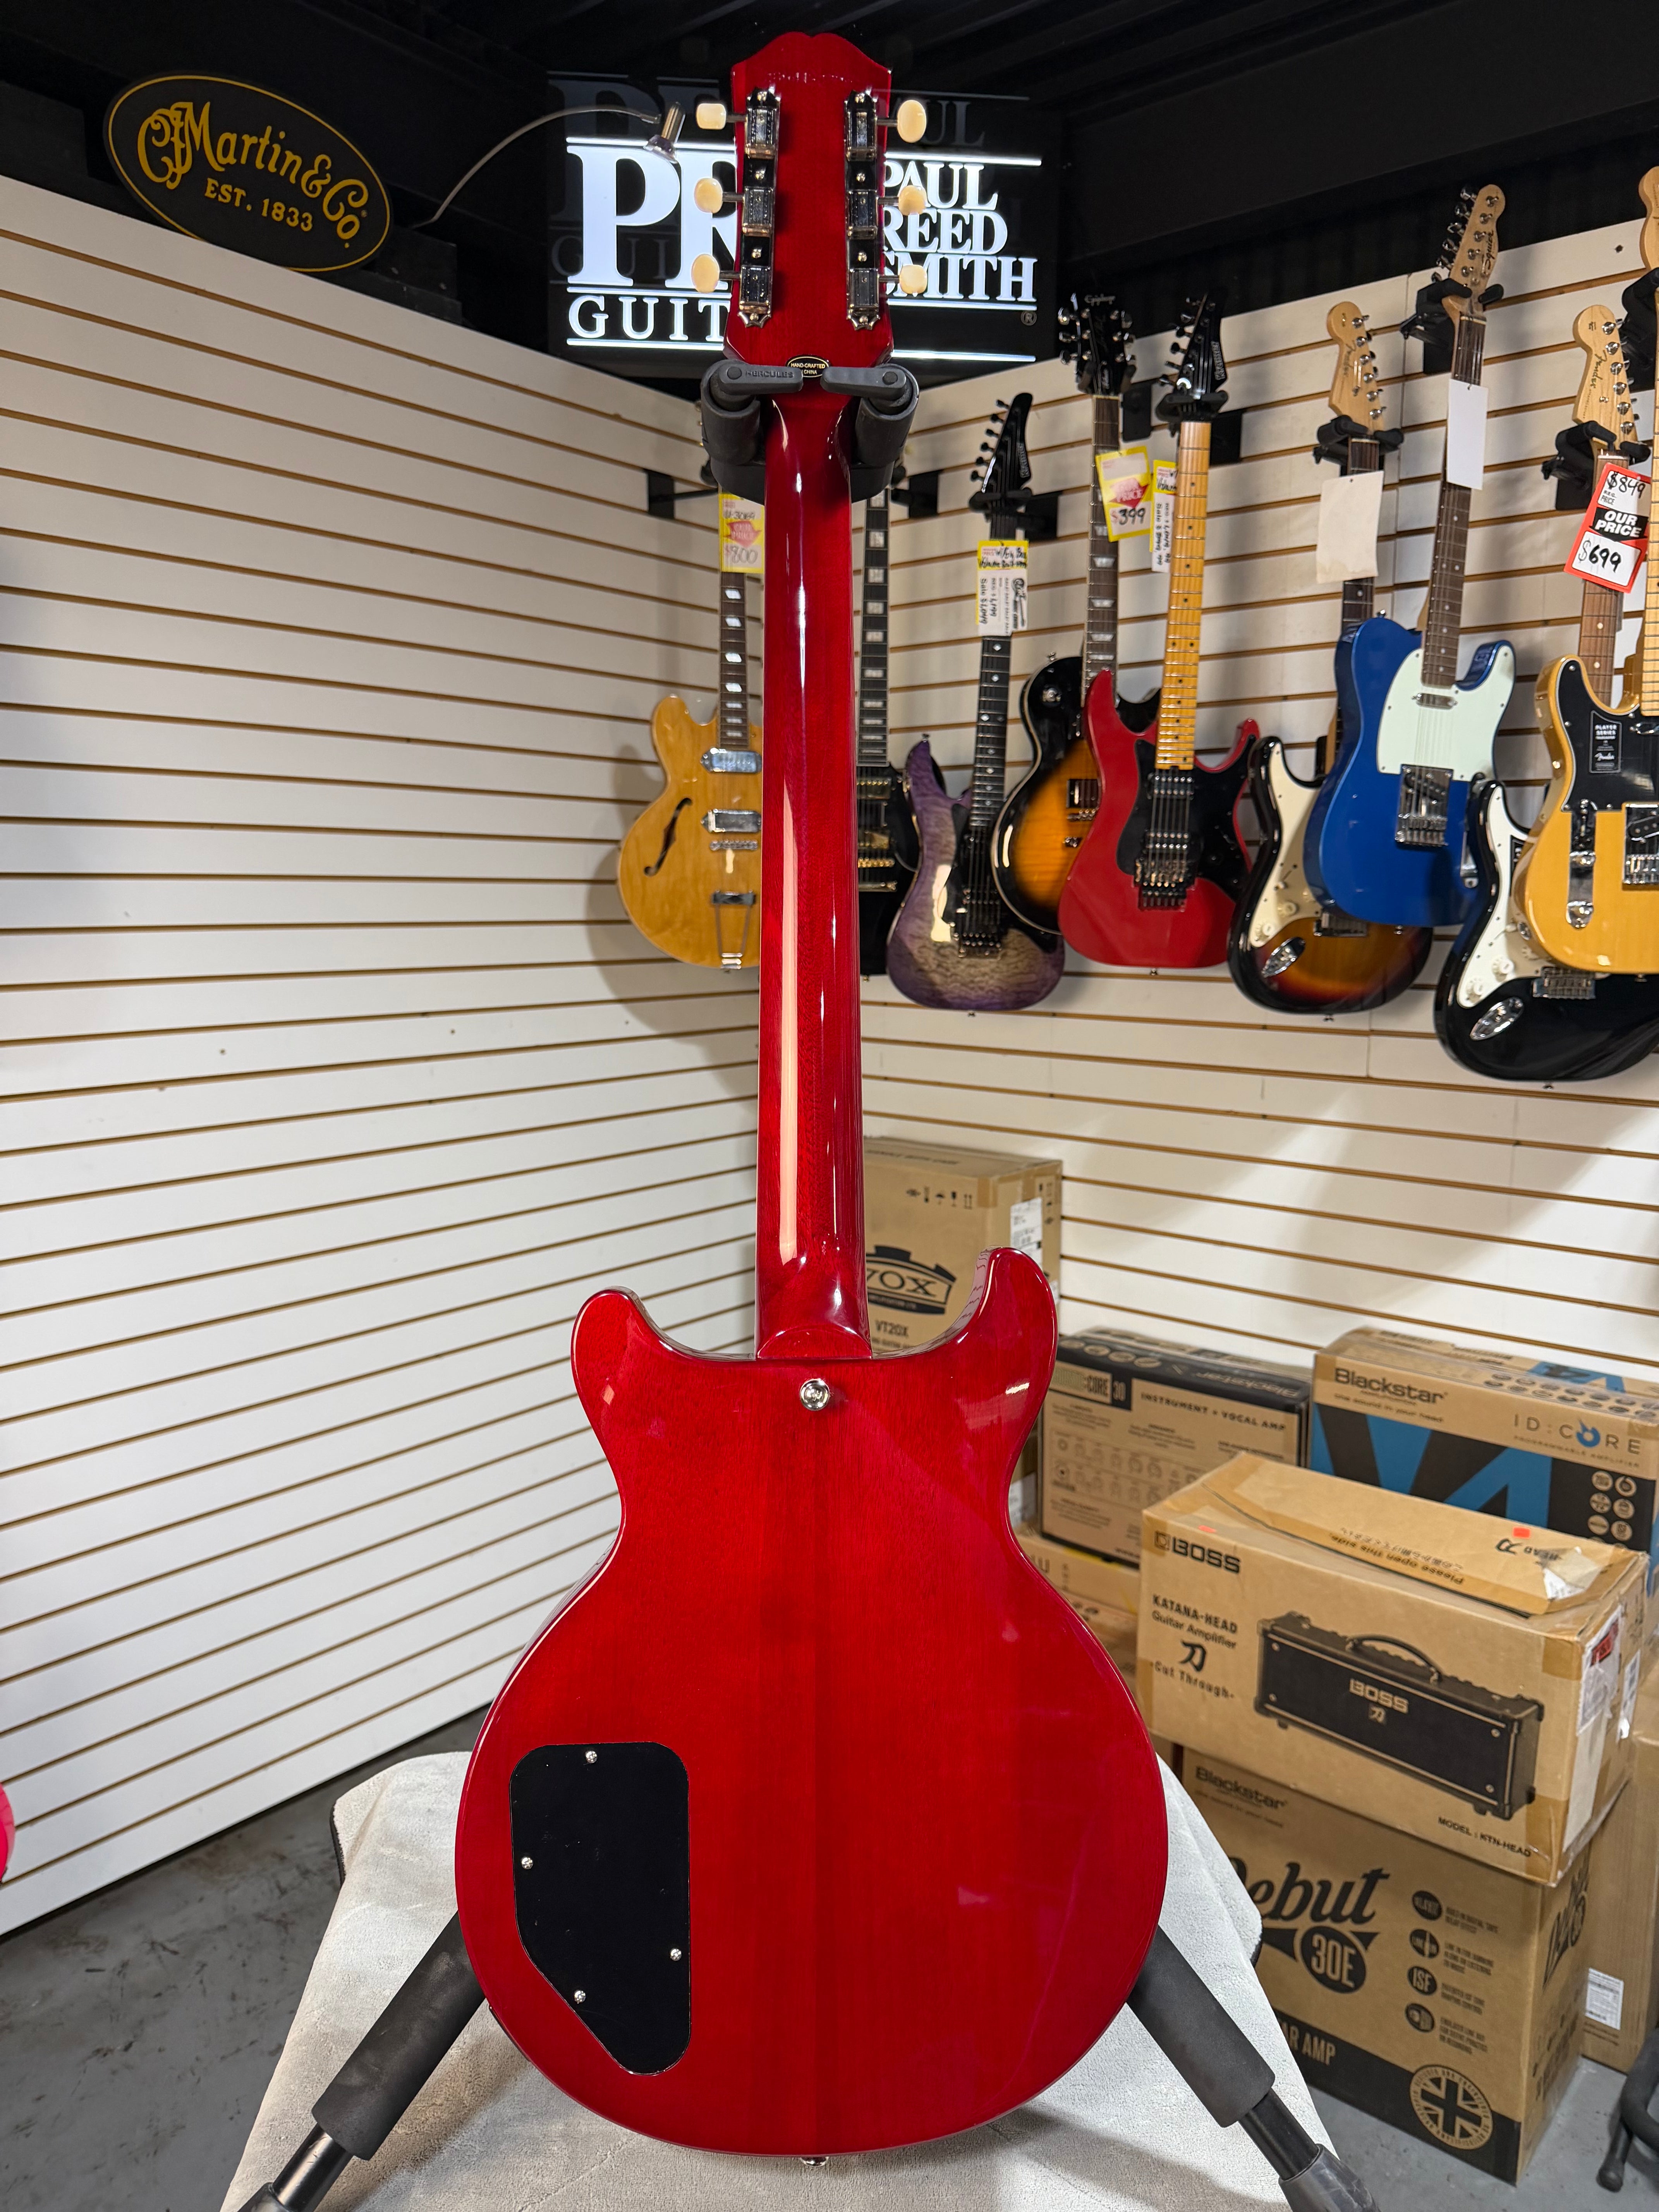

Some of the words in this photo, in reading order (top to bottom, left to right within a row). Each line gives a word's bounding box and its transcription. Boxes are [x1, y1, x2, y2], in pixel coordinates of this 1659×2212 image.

[205, 178, 252, 211] EST.
[262, 198, 313, 232] 1833
[1482, 230, 1495, 270] Squier
[568, 295, 731, 343] GUIT
[1590, 349, 1607, 389] Fender
[1607, 471, 1646, 499] $849
[1594, 519, 1642, 538] PRICE
[1604, 510, 1638, 526] OUR
[1578, 538, 1621, 573] $699
[1334, 1367, 1445, 1404] Blackstar
[1141, 1391, 1208, 1413] INSTRUMENT
[1221, 1410, 1258, 1426] VOCAL
[1261, 1419, 1286, 1431] AMP
[1172, 1538, 1242, 1574] BOSS
[1360, 1544, 1383, 1558] this
[1386, 1553, 1418, 1569] open
[1421, 1565, 1465, 1585] Please
[1151, 1609, 1184, 1630] Guitar
[1186, 1624, 1237, 1649] Amplifier
[1152, 1594, 1238, 1634] KATANA-HEAD
[1154, 1661, 1175, 1677] Cut
[1349, 1678, 1409, 1714] BOSS
[1195, 1765, 1285, 1809] Blackstar
[1438, 1816, 1472, 1837] MODEL
[1479, 1831, 1532, 1857] KTN-HEAD
[1311, 1932, 1355, 1989] 30E
[1413, 1967, 1433, 1993] ISF
[1302, 2033, 1336, 2066] AMP
